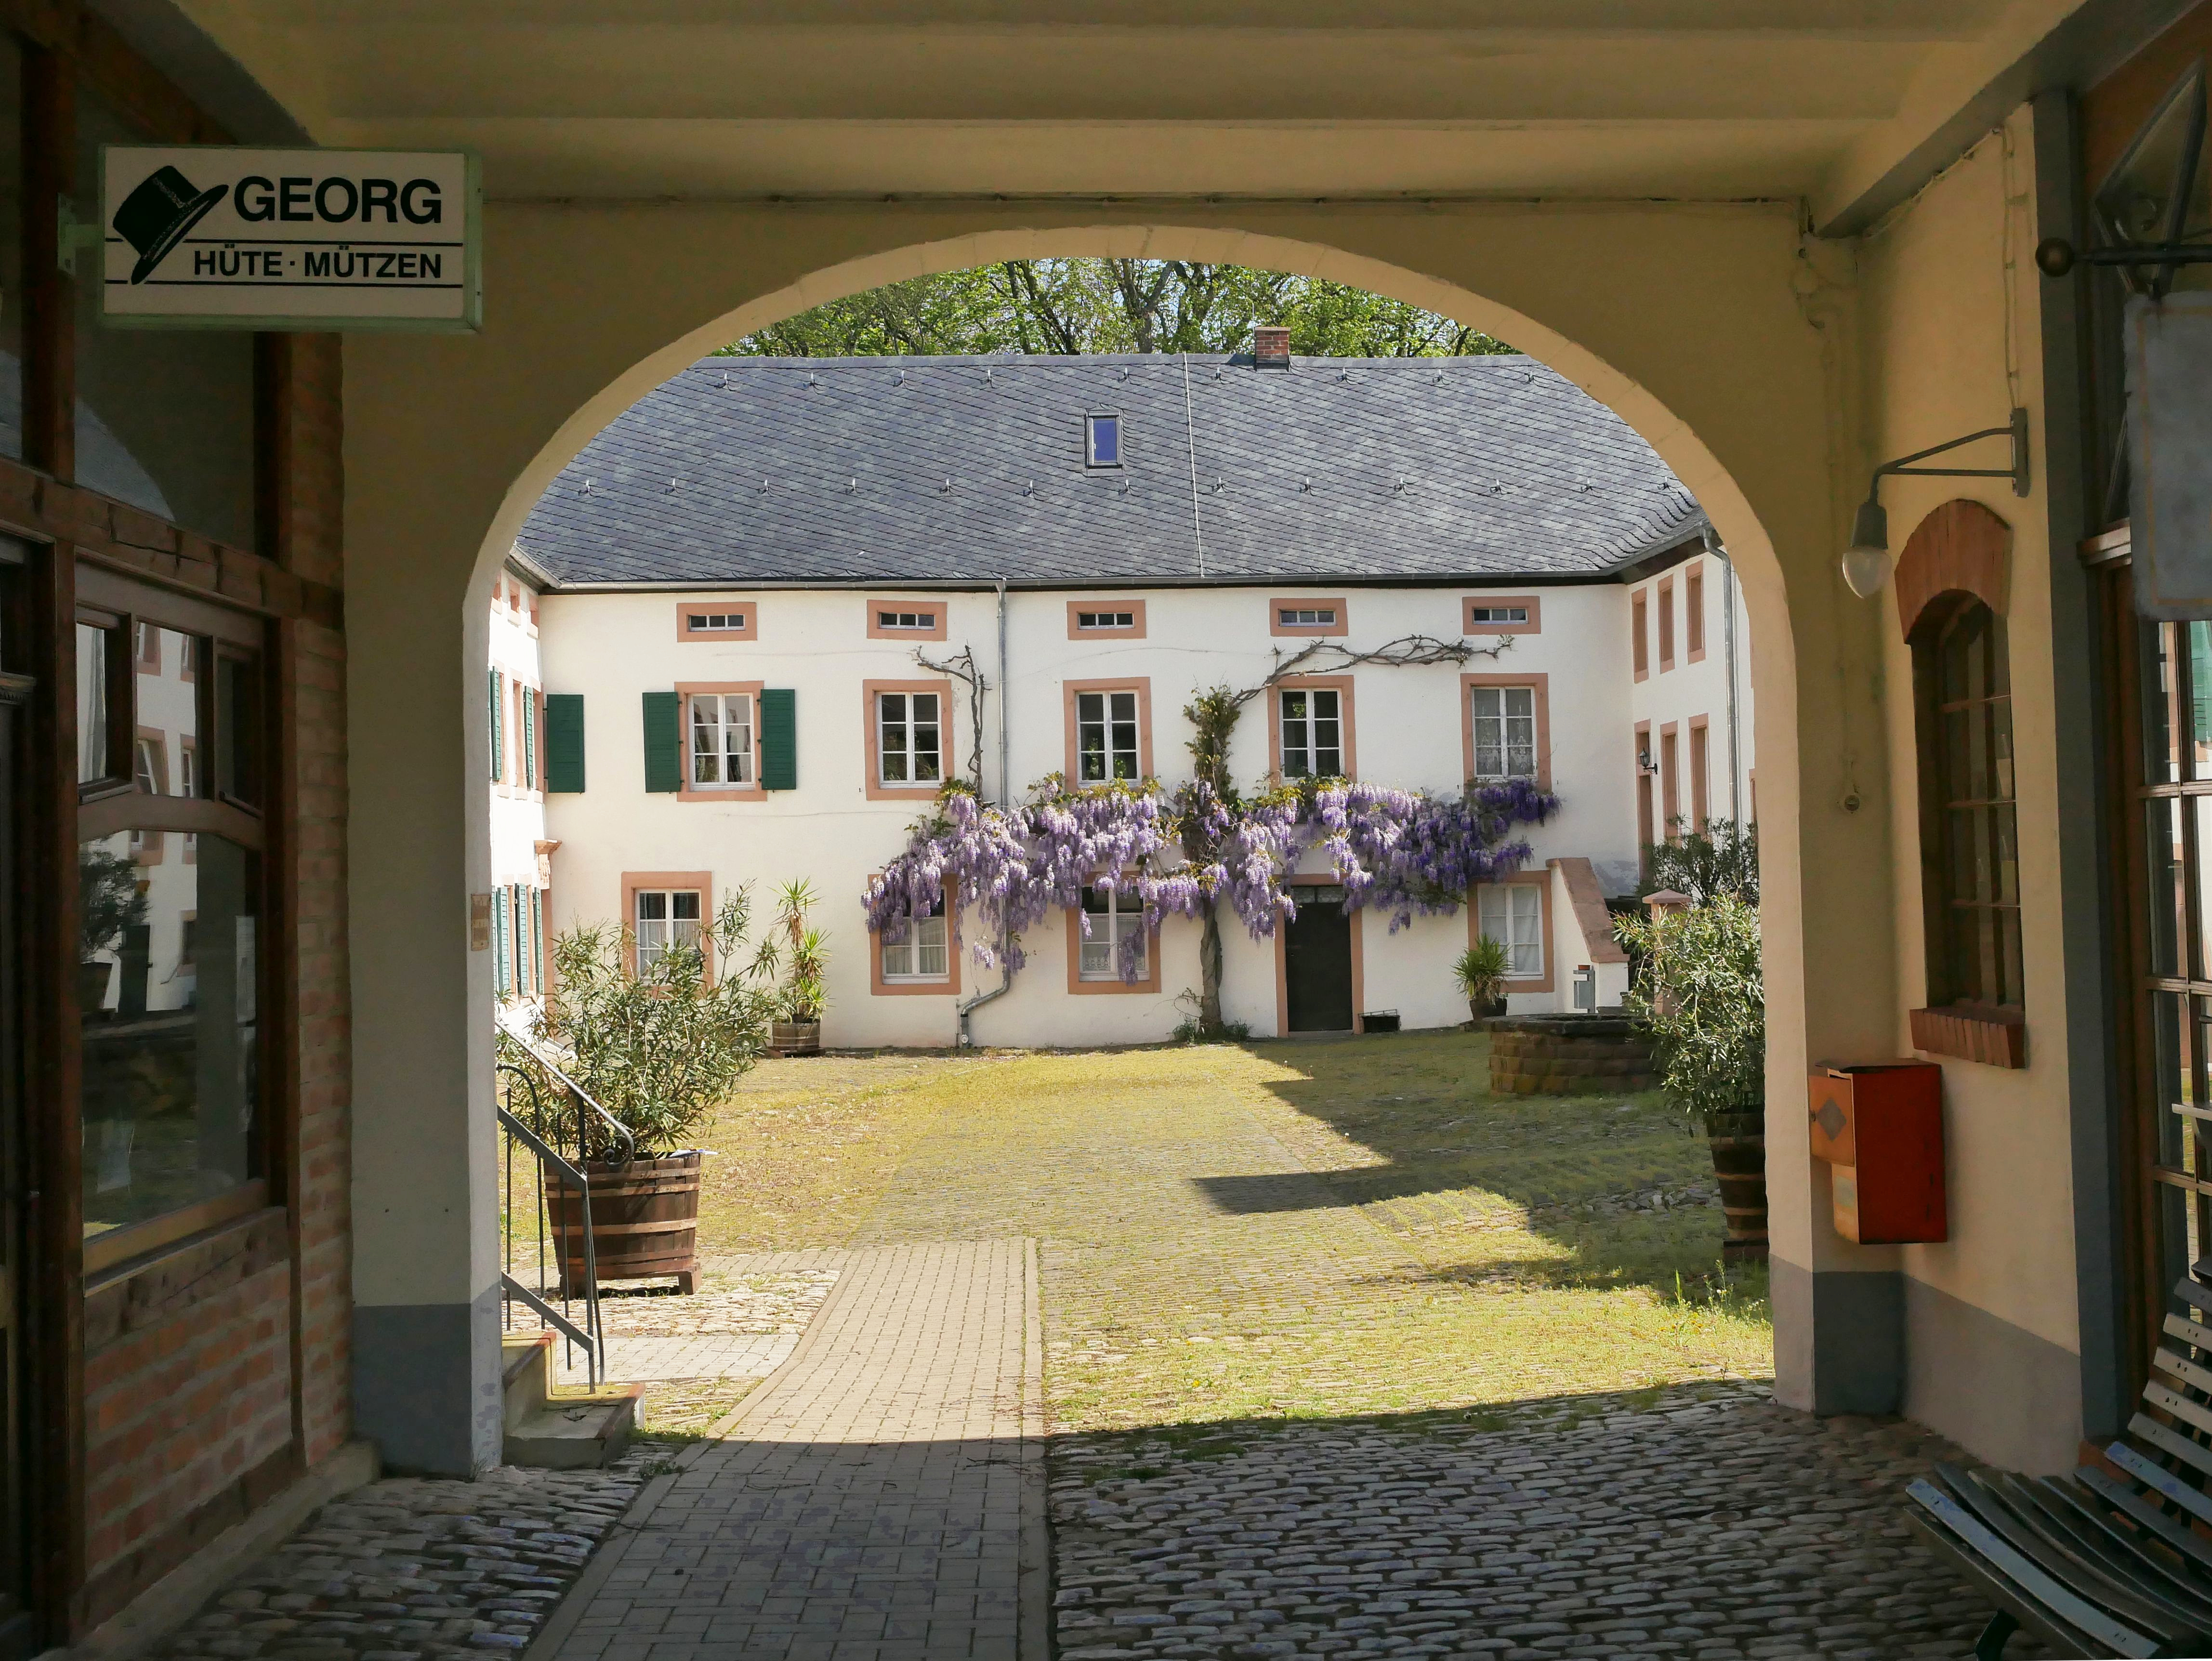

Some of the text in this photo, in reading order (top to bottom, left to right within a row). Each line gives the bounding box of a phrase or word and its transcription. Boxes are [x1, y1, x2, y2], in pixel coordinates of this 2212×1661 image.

[234, 175, 442, 225] GEORG
[194, 243, 283, 277] HÜTE
[304, 245, 441, 279] MÜTZEN
